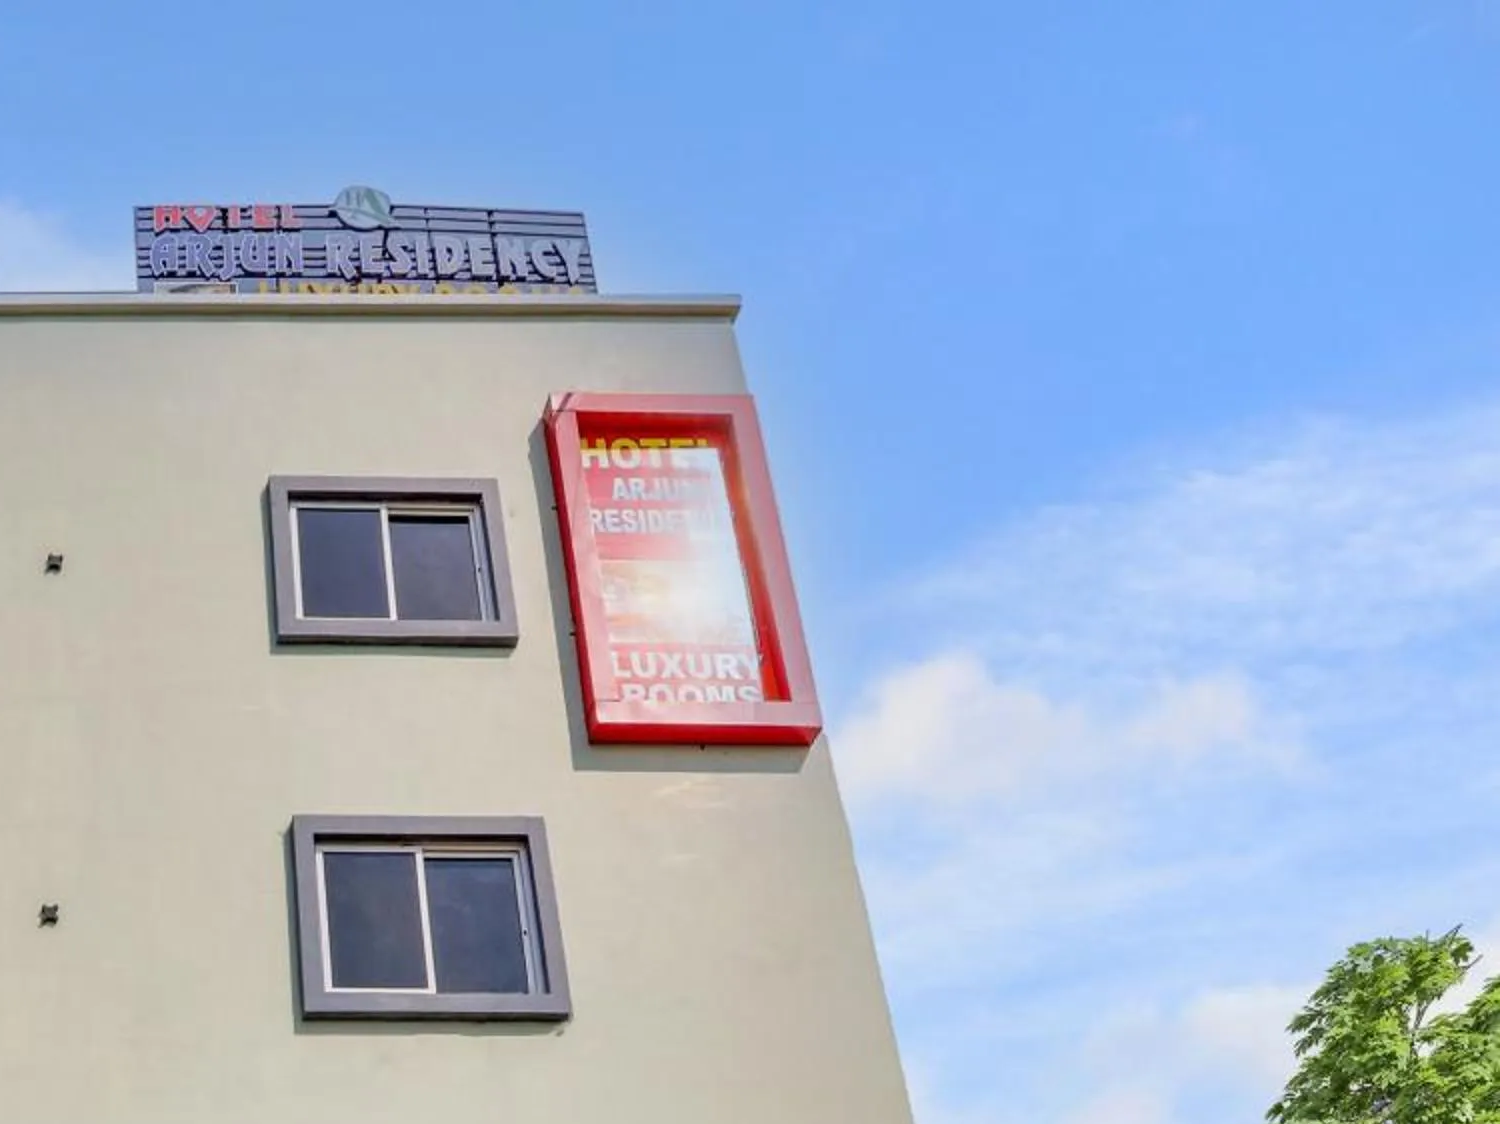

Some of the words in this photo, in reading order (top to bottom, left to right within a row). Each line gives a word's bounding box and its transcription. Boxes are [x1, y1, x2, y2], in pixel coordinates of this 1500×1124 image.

[151, 233, 304, 281] ARJUN
[325, 232, 585, 285] RESIDENCY
[610, 651, 763, 680] LUXURY
